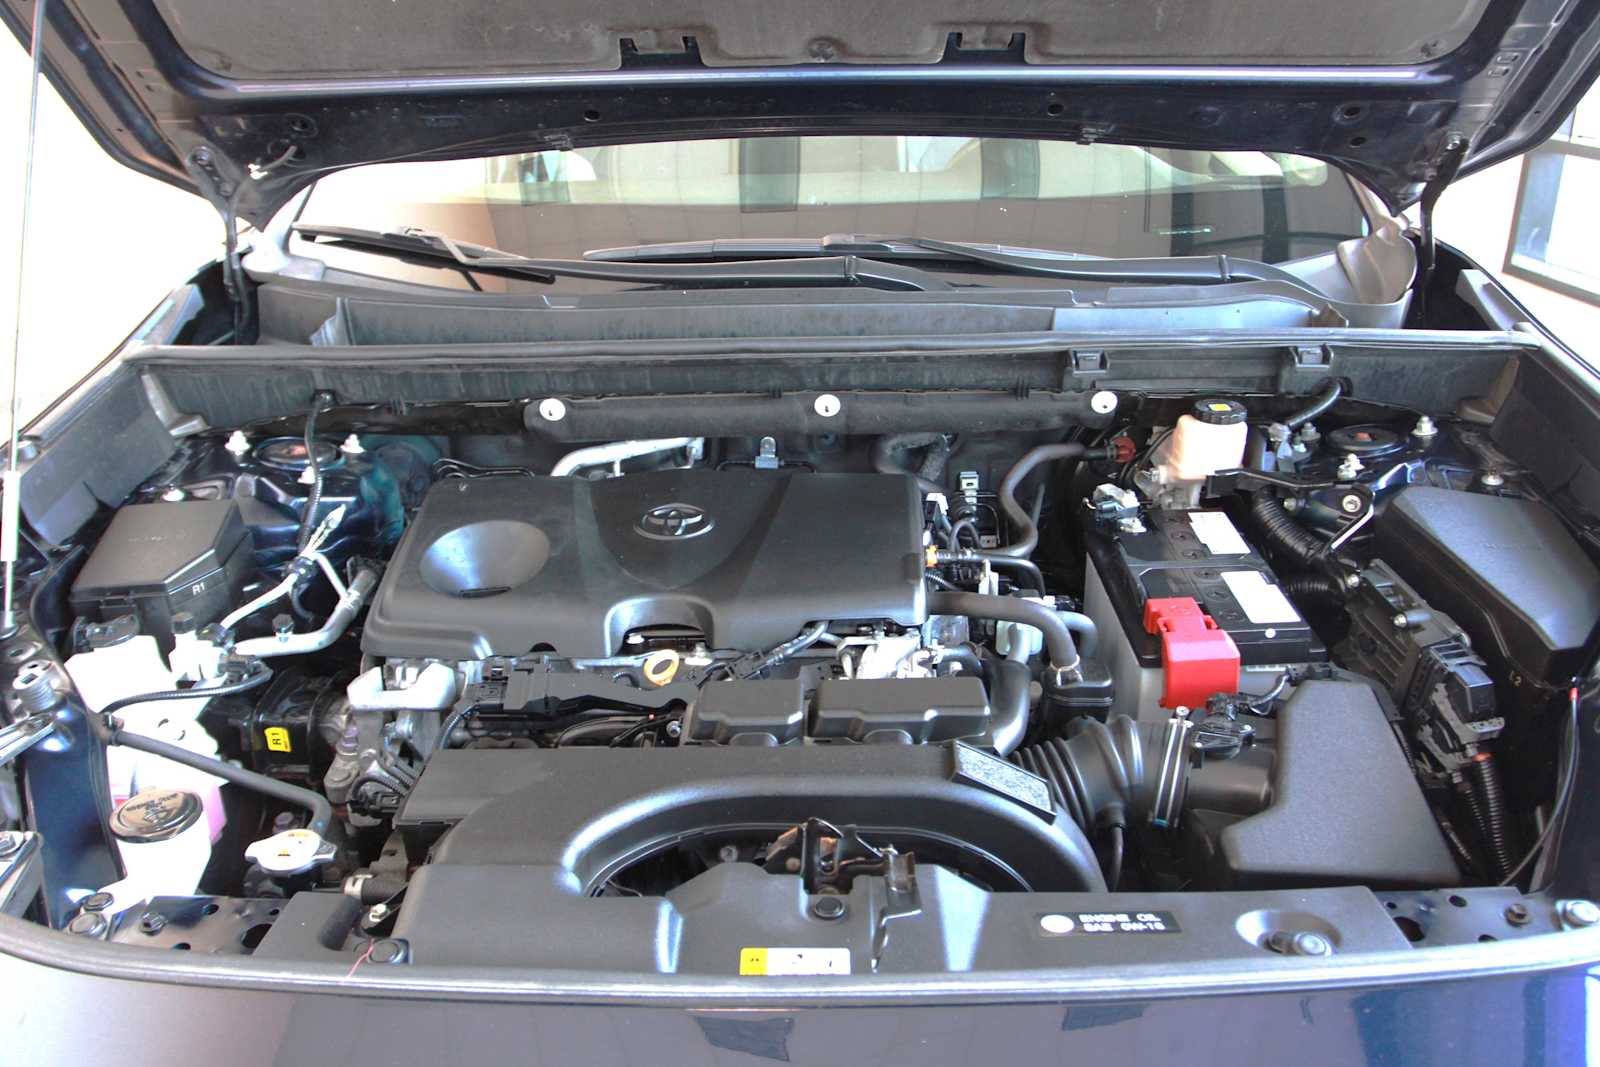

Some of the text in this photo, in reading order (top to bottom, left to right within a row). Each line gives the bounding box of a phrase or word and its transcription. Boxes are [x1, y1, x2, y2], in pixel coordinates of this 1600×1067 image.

[192, 582, 205, 596] R1
[1078, 913, 1162, 923] ENGINE OIL
[1083, 922, 1115, 932] SAE
